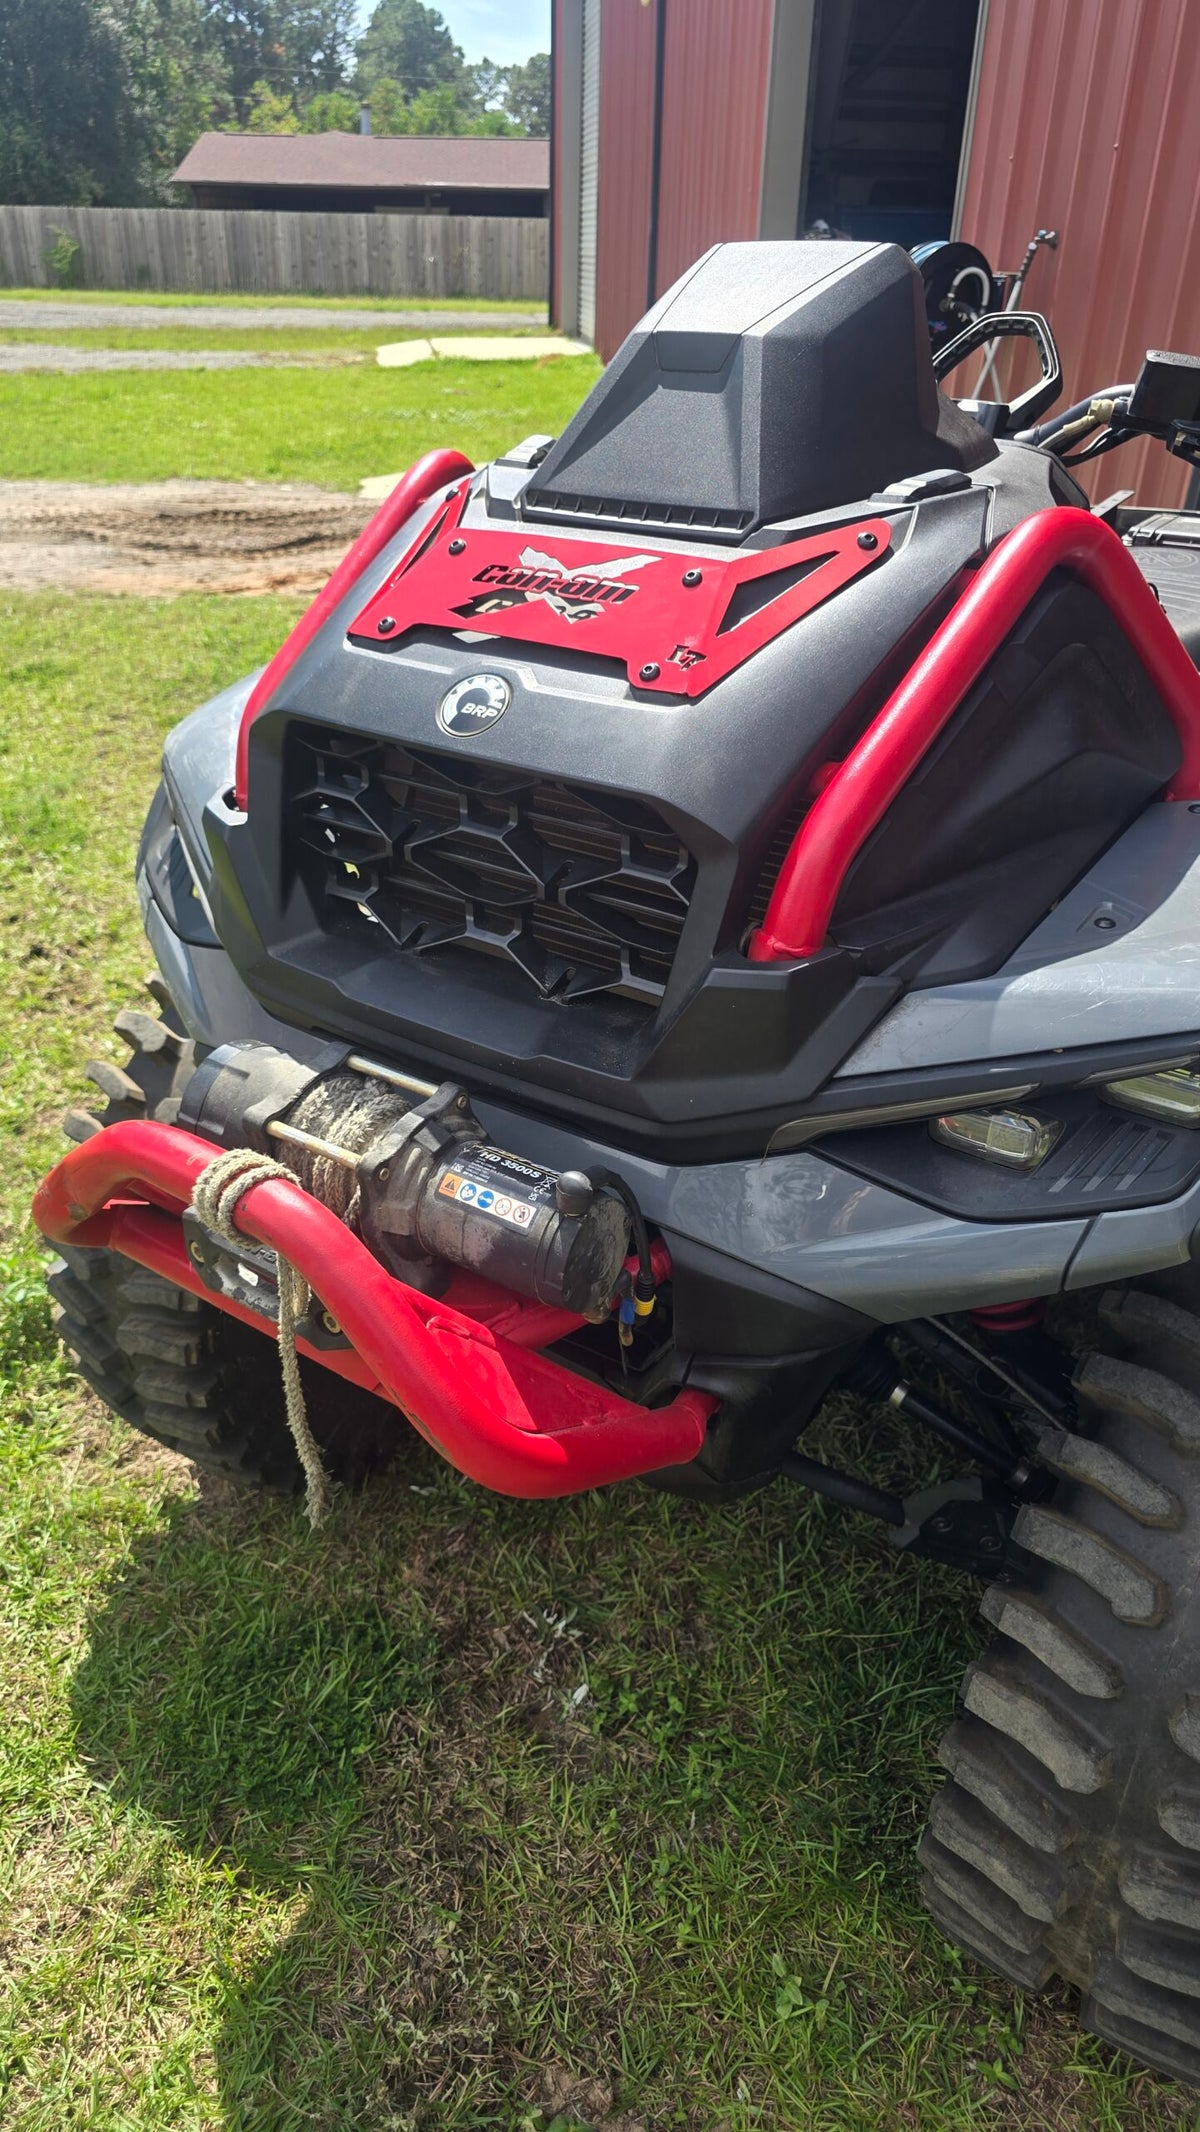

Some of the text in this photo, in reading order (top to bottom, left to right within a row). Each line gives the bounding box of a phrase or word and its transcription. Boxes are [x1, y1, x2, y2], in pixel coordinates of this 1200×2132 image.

[461, 702, 498, 719] BRP
[479, 1151, 501, 1162] HD
[501, 1160, 541, 1179] 3500S
